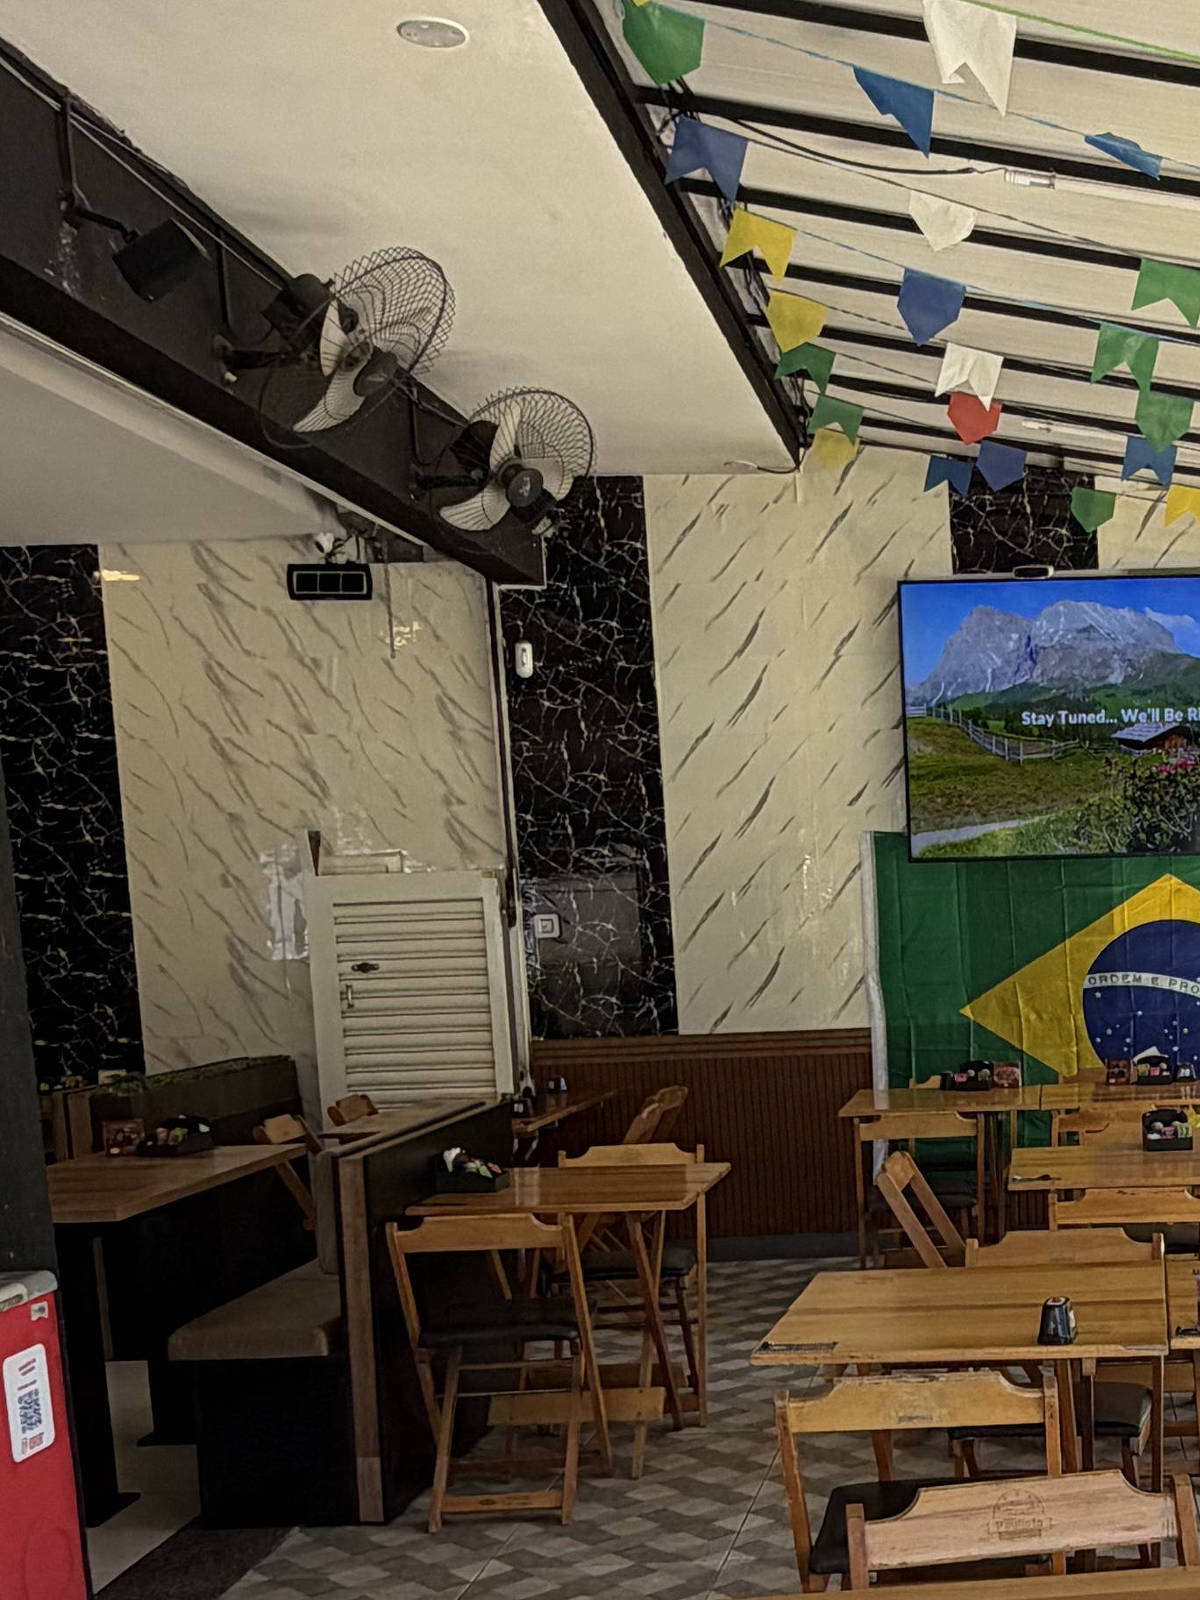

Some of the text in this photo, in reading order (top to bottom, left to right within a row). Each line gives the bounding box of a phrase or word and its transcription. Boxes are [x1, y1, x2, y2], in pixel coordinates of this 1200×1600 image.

[1021, 711, 1055, 727] Stay
[1057, 710, 1118, 725] Tuned...
[1121, 709, 1160, 723] We'll
[1164, 708, 1184, 722] Be
[1087, 974, 1142, 986] ORDEM
[1151, 977, 1160, 986] E
